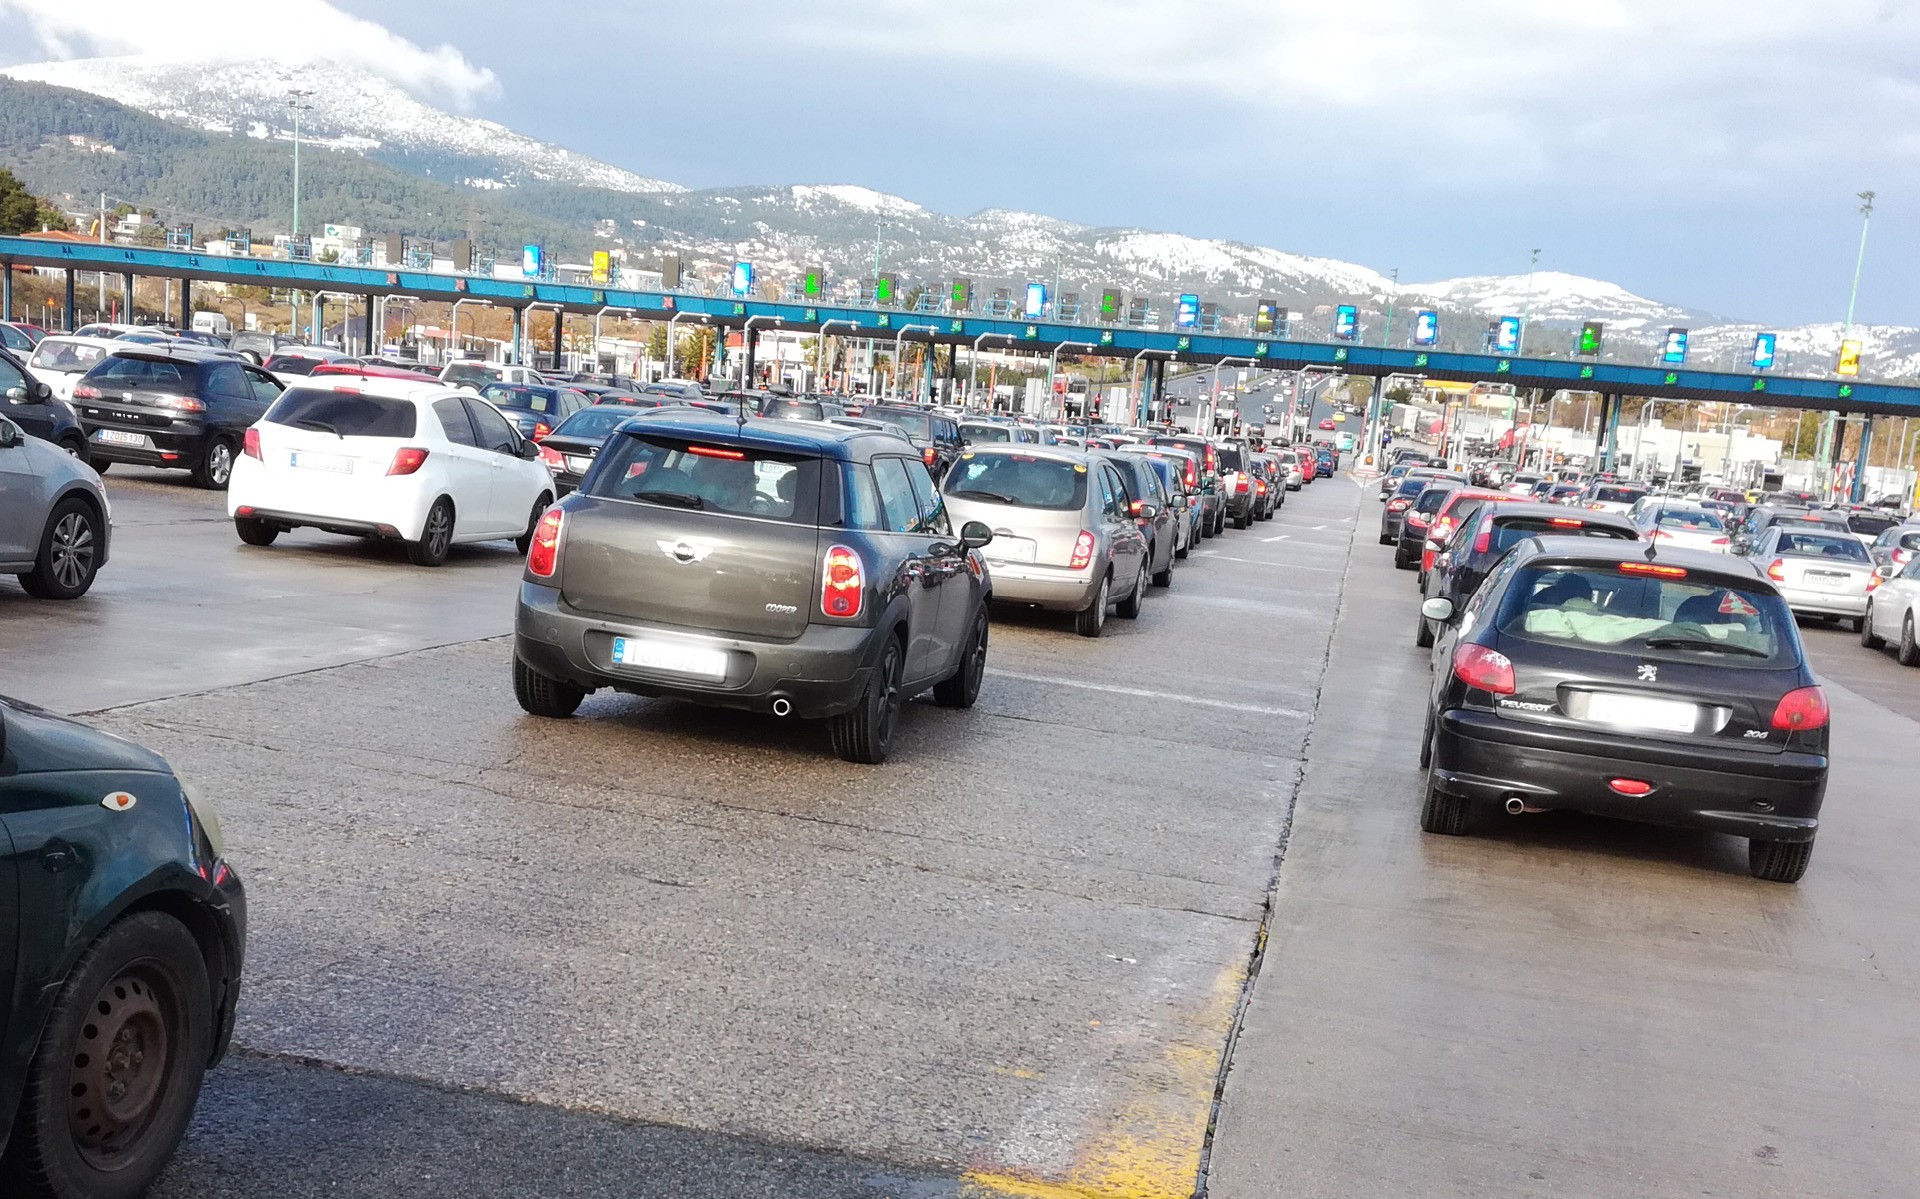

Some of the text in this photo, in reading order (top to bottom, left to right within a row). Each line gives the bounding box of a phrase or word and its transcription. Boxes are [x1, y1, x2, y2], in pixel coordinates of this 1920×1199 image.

[765, 603, 798, 615] COOPER
[1500, 700, 1551, 712] PEUGEOT
[1743, 729, 1769, 739] 206
